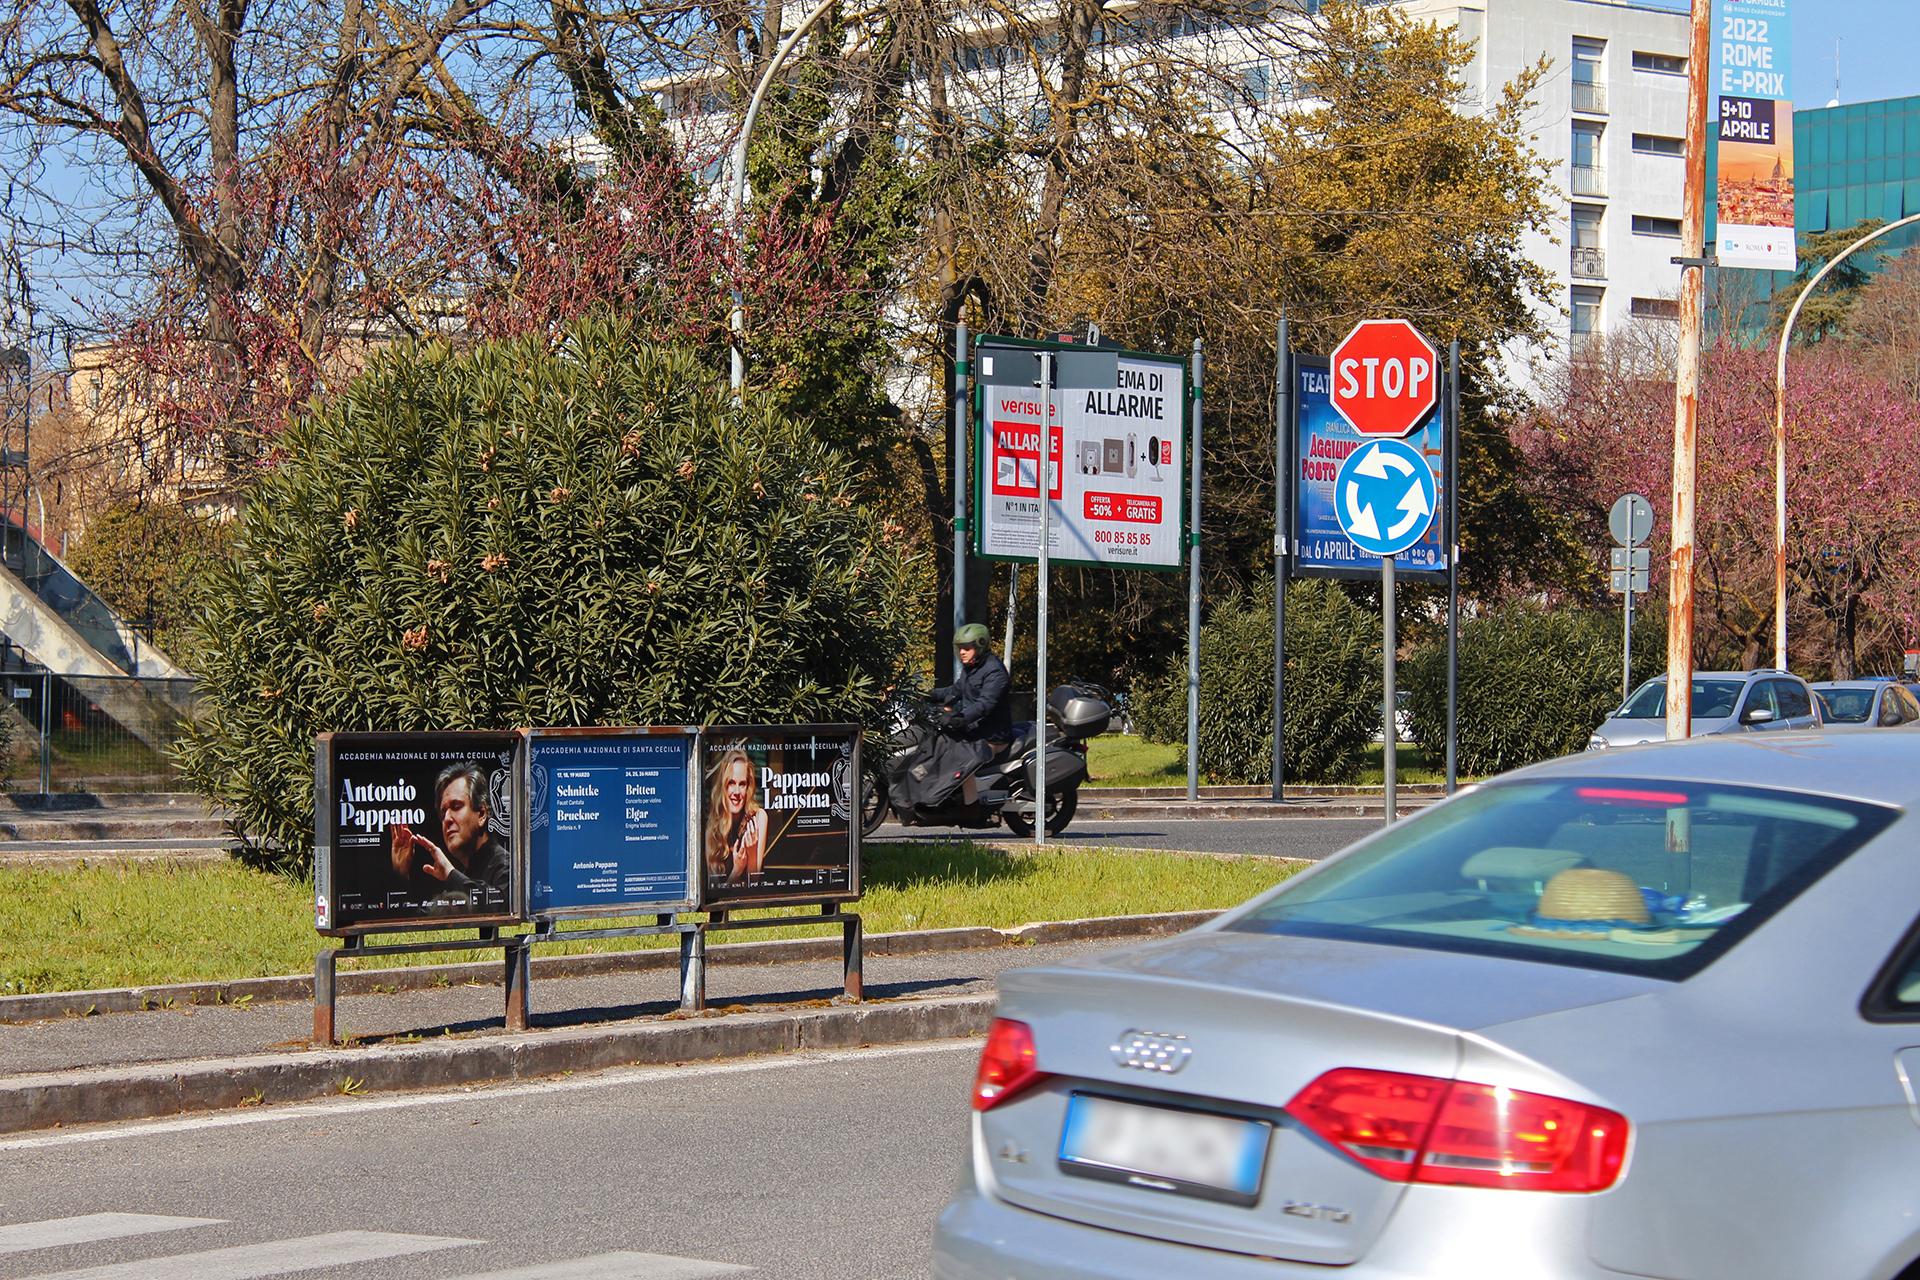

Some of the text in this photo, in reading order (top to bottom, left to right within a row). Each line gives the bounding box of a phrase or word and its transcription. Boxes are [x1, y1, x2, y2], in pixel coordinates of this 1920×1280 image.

[1722, 16, 1768, 43] 2022
[1722, 42, 1773, 69] ROME
[1721, 67, 1784, 96] E-PRIX
[1721, 100, 1752, 119] 9+10
[1721, 119, 1770, 140] APRILE
[1117, 369, 1163, 392] EMA DI
[1301, 371, 1330, 394] TEAT
[1339, 357, 1430, 399] STOP
[1001, 399, 1056, 417] verisue
[1085, 390, 1163, 420] ALLARME
[997, 431, 1058, 453] ALLARE
[1301, 458, 1337, 482] POSTO
[1028, 503, 1040, 513] ITA
[1090, 495, 1111, 503] OFFERTA
[1090, 504, 1112, 517] -50%
[1126, 506, 1156, 520] GRATIS
[1094, 530, 1151, 545] 800 85 85 85
[1107, 545, 1138, 556] verisure.it
[1301, 546, 1313, 559] DAL
[1314, 540, 1321, 560] 6
[1323, 541, 1356, 561] APRILE
[386, 752, 428, 760] NAZIONALE
[466, 751, 496, 759] CECILIA
[655, 745, 681, 753] CECILIA
[709, 744, 746, 752] ACCADEMIA
[761, 766, 830, 794] Pappano
[339, 778, 417, 802] Antonio
[556, 784, 599, 797] Schnittke
[625, 784, 656, 796] Britten
[764, 788, 830, 810] Lamsma
[339, 801, 426, 833] Pappano
[556, 809, 600, 821] Bruckner
[625, 807, 649, 822] Elgar
[595, 861, 618, 869] Pappano
